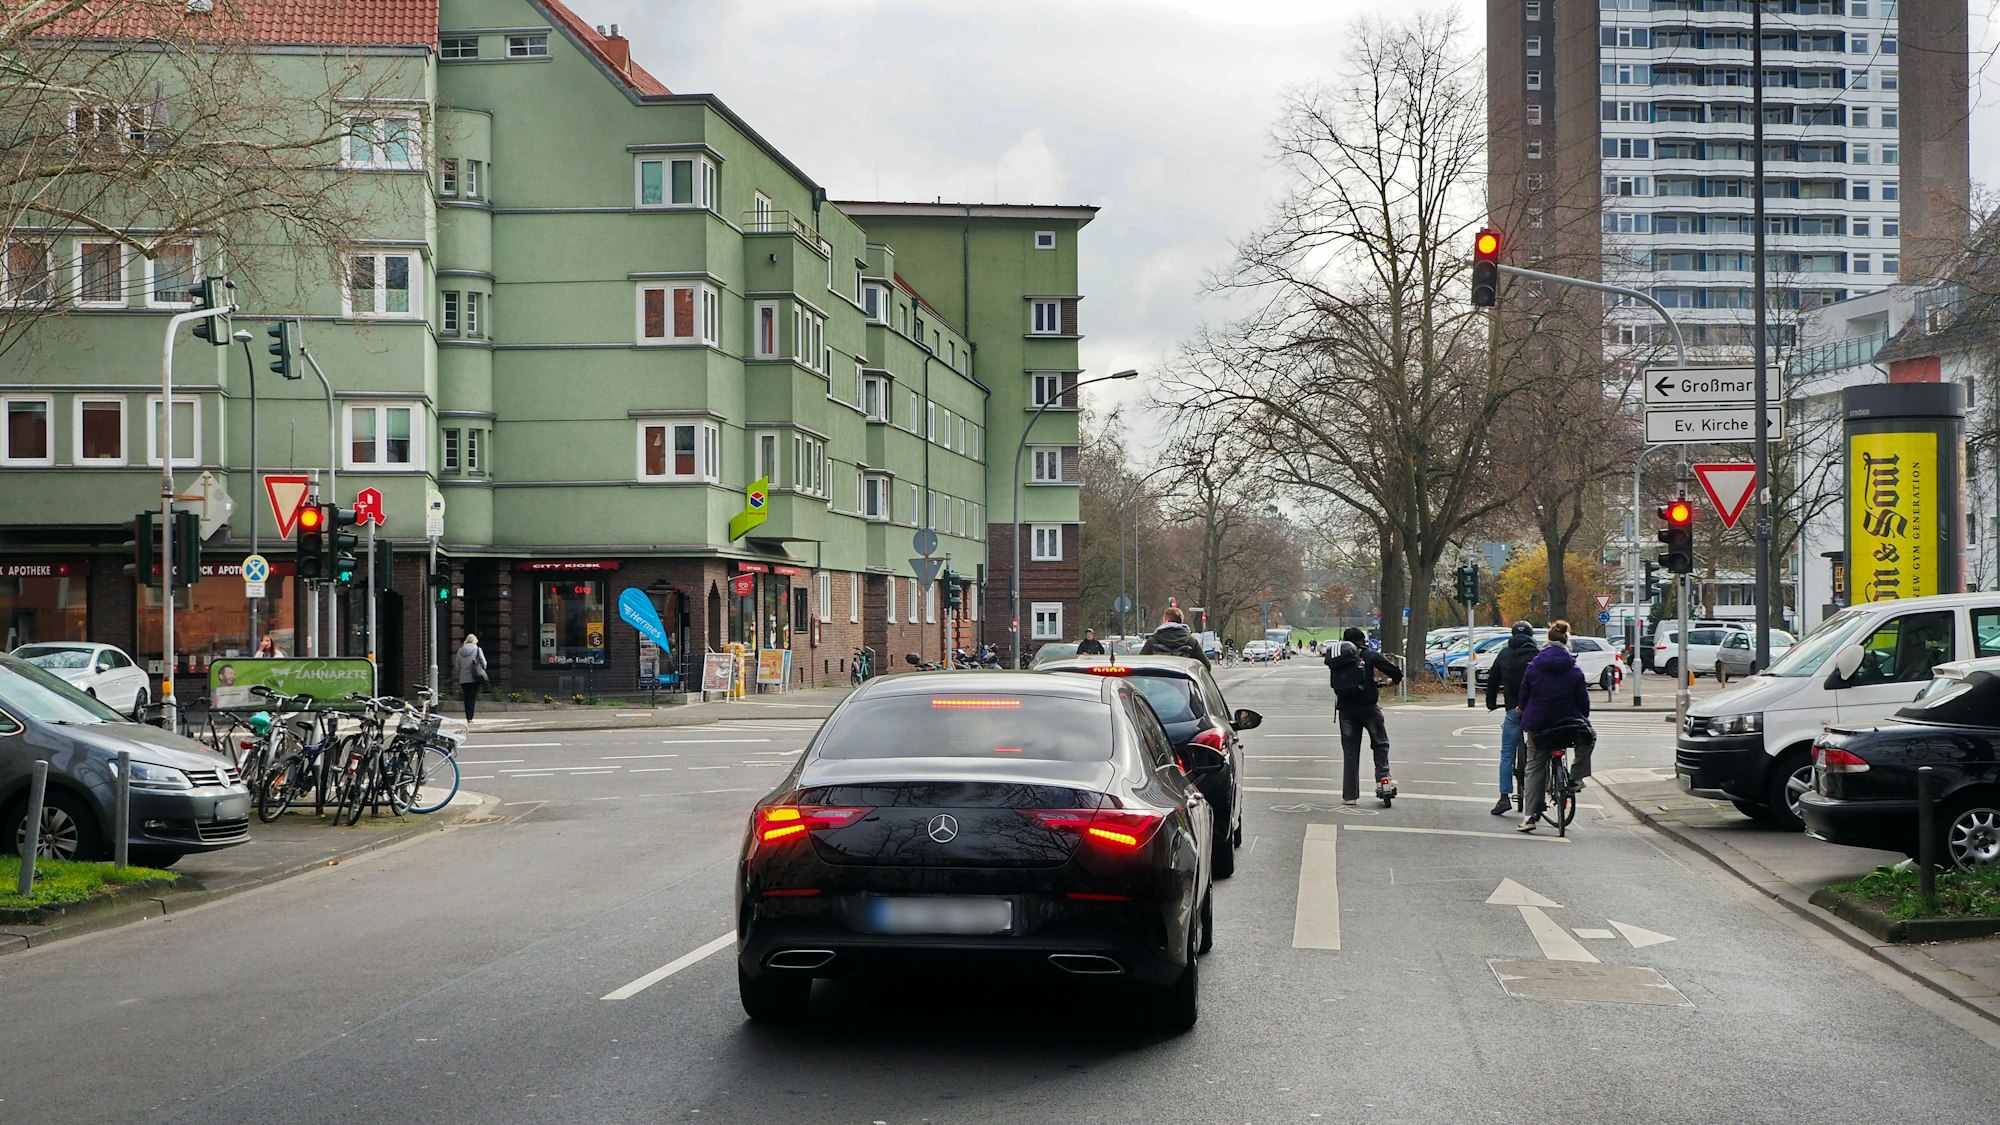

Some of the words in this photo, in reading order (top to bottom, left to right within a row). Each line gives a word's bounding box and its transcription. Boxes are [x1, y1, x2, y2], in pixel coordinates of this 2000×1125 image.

[1681, 378, 1768, 392] Großmar
[1675, 420, 1695, 432] Ev.
[1701, 418, 1748, 431] Kirche
[1912, 461, 1920, 539] GENERATION
[1872, 542, 1900, 563] &
[1912, 545, 1920, 570] GYM
[8, 565, 51, 576] APOTHEKE
[218, 565, 243, 575] APOTH
[629, 611, 662, 639] Hermes
[295, 667, 368, 679] ZAHNÄRZTE
